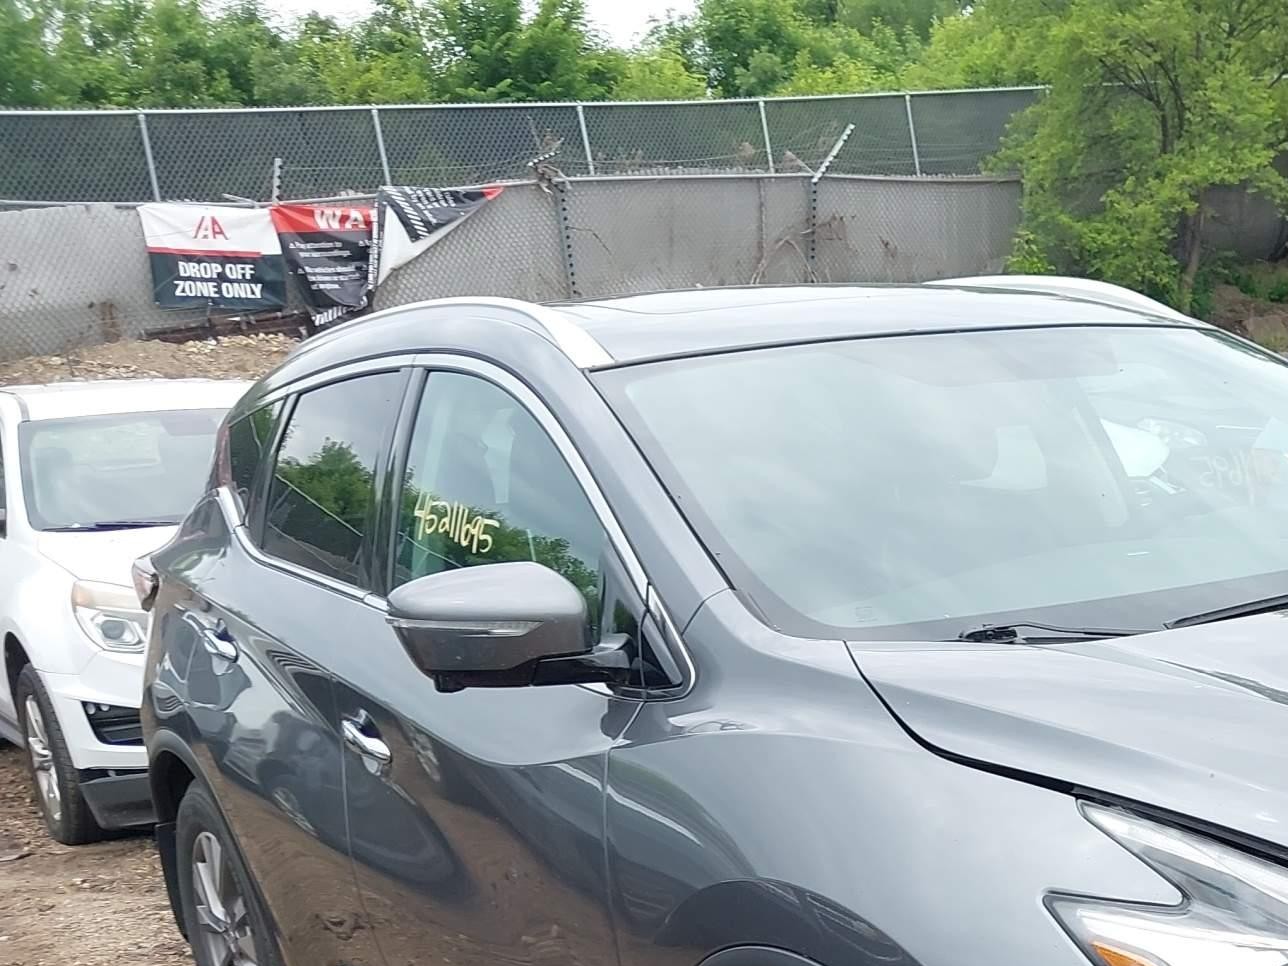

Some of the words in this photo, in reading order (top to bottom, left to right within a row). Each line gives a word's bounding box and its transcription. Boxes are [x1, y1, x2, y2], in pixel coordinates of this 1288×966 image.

[178, 261, 223, 279] DROP
[224, 262, 255, 278] OFF
[174, 280, 218, 299] ZONE
[222, 282, 263, 299] ONLY
[414, 492, 500, 554] 45211695
